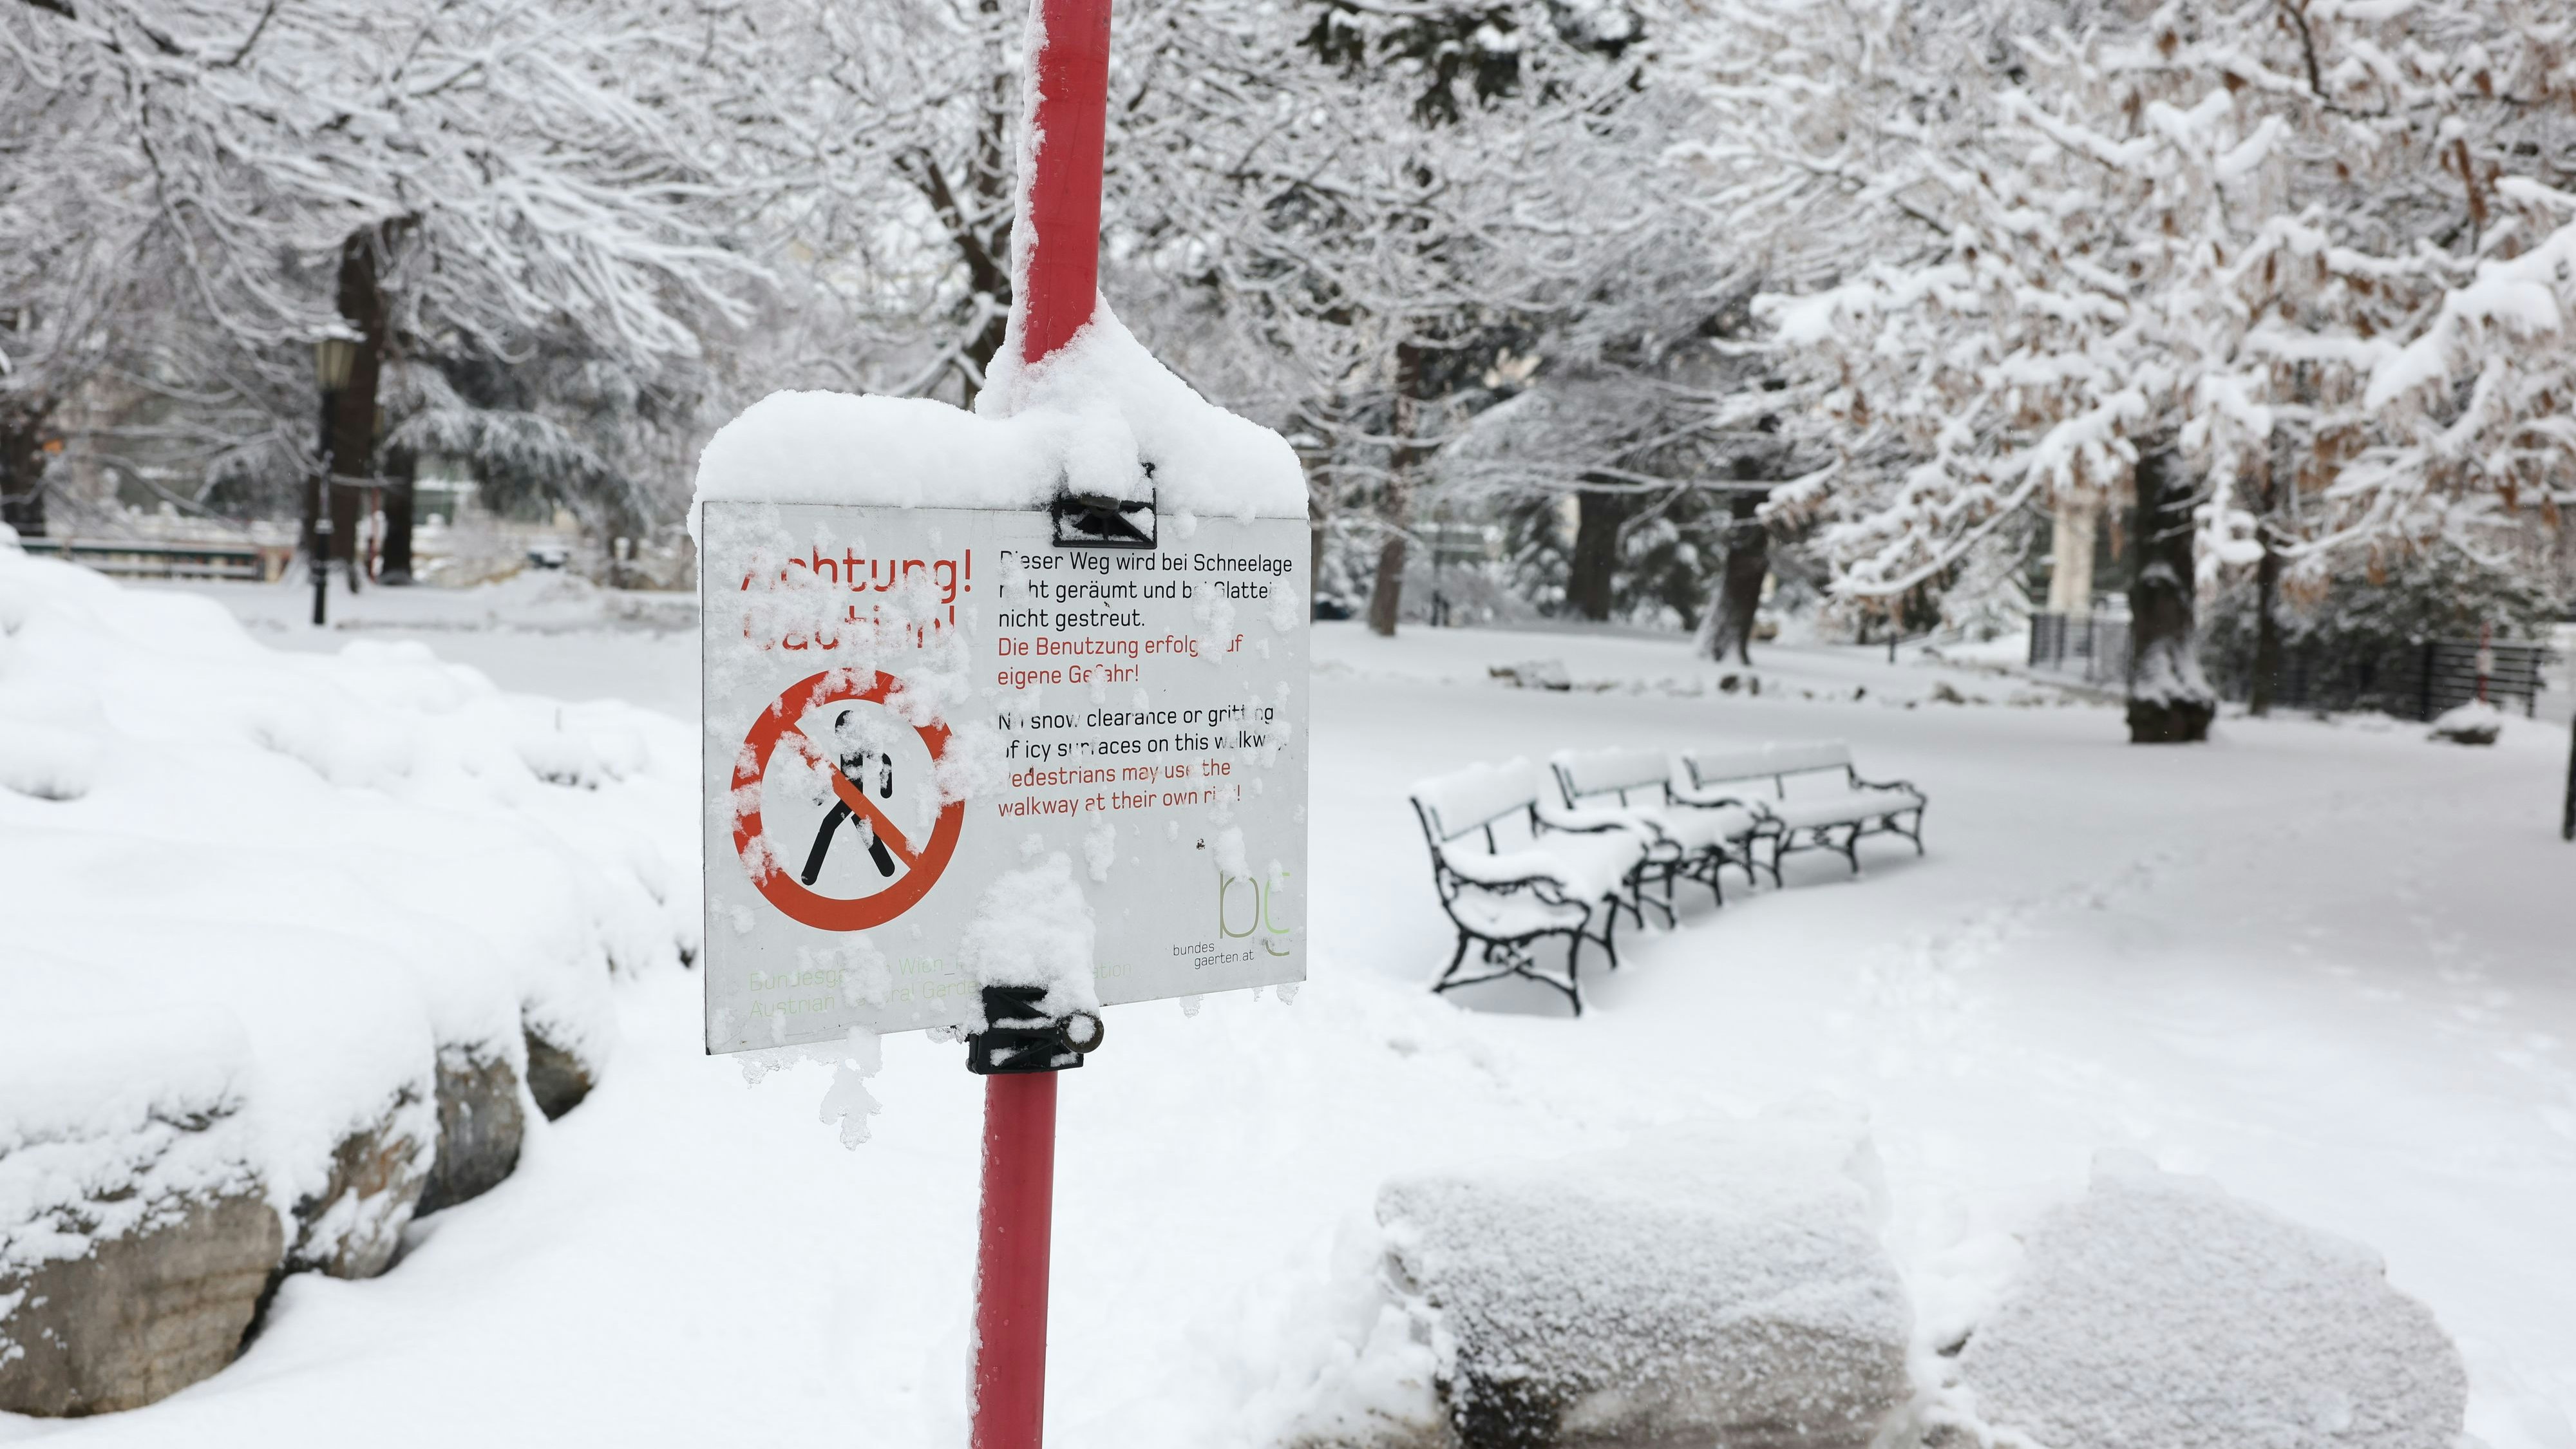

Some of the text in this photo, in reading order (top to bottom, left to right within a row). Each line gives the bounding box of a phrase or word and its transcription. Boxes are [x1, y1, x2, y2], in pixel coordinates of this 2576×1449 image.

[1070, 552, 1110, 574] Weg
[1117, 553, 1155, 570] wird
[1162, 554, 1188, 571] bei
[1193, 554, 1293, 576] Schneelage
[1056, 580, 1137, 603] geräumt
[1144, 581, 1175, 598] und
[999, 609, 1146, 632] nicht gestreut.
[999, 637, 1028, 656] Die
[1036, 637, 1139, 658] Benutzung
[1145, 634, 1198, 657] erfolg
[998, 664, 1139, 689] eigene Geahr!
[1087, 708, 1177, 727] clearance
[1184, 710, 1203, 724] or
[1026, 741, 1051, 762] icy
[1148, 737, 1169, 752] on
[1175, 734, 1209, 750] this
[1122, 764, 1159, 784] may
[1202, 758, 1231, 777] the
[999, 796, 1079, 817] walkway
[1112, 790, 1157, 809] their
[1162, 791, 1198, 806] own
[1173, 942, 1215, 956] bundes
[1194, 950, 1255, 970] gaerten.at
[749, 994, 835, 1018] Austrian
